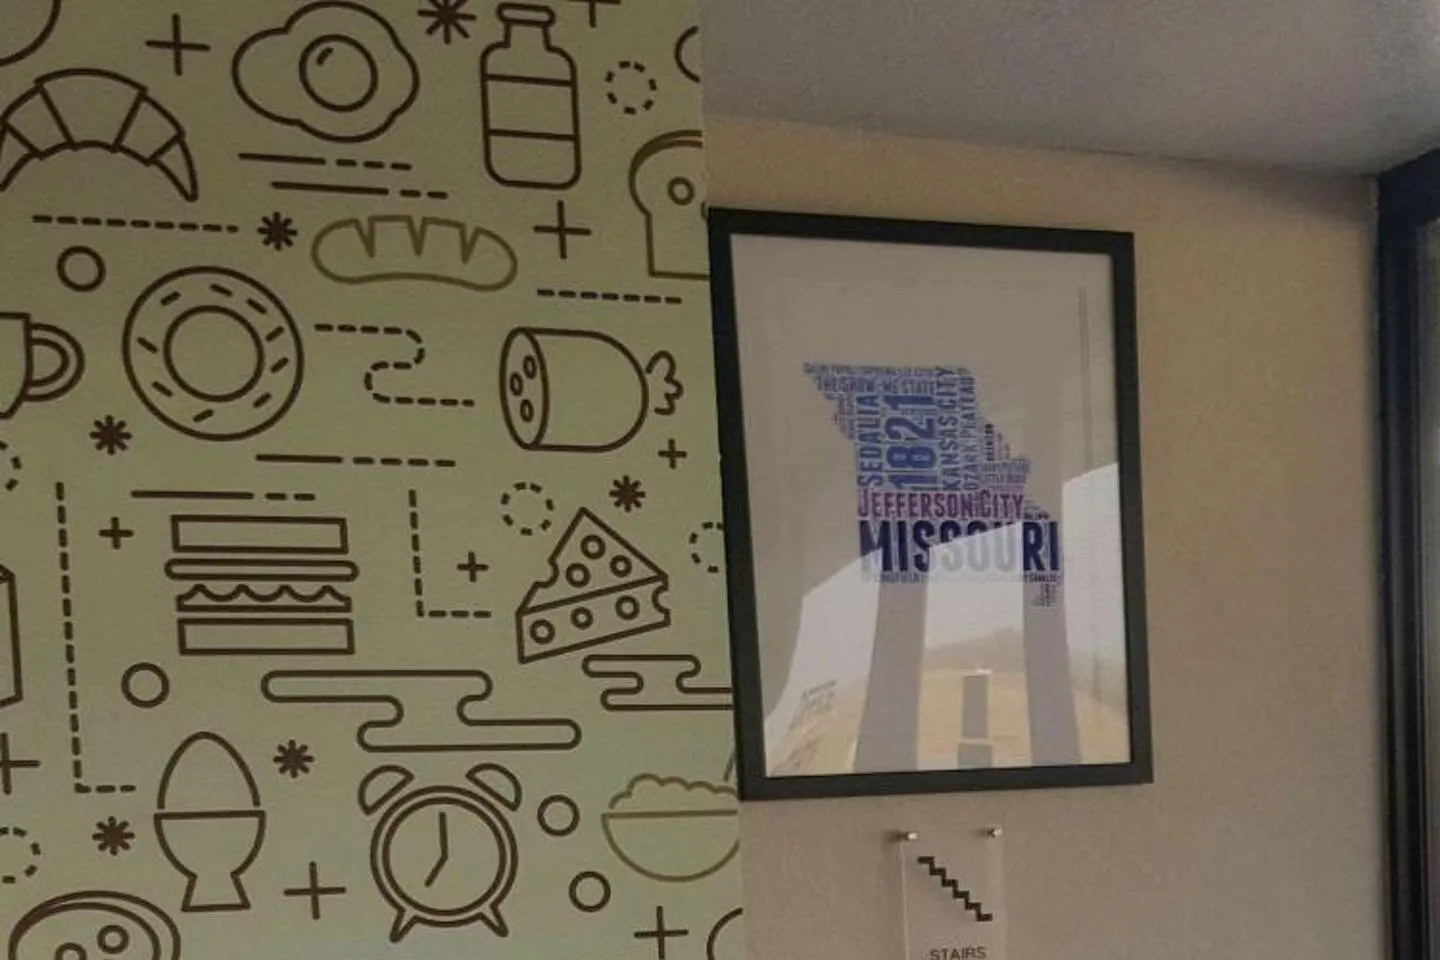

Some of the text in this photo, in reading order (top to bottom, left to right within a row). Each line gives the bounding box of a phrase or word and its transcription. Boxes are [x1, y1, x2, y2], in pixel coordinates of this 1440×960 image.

[857, 395, 884, 487] SEDALIA
[884, 394, 938, 490] 1821
[936, 366, 961, 491] KANSAS CITY
[858, 489, 1024, 518] JEFFERSON CITY
[859, 519, 1061, 572] MISSOURI
